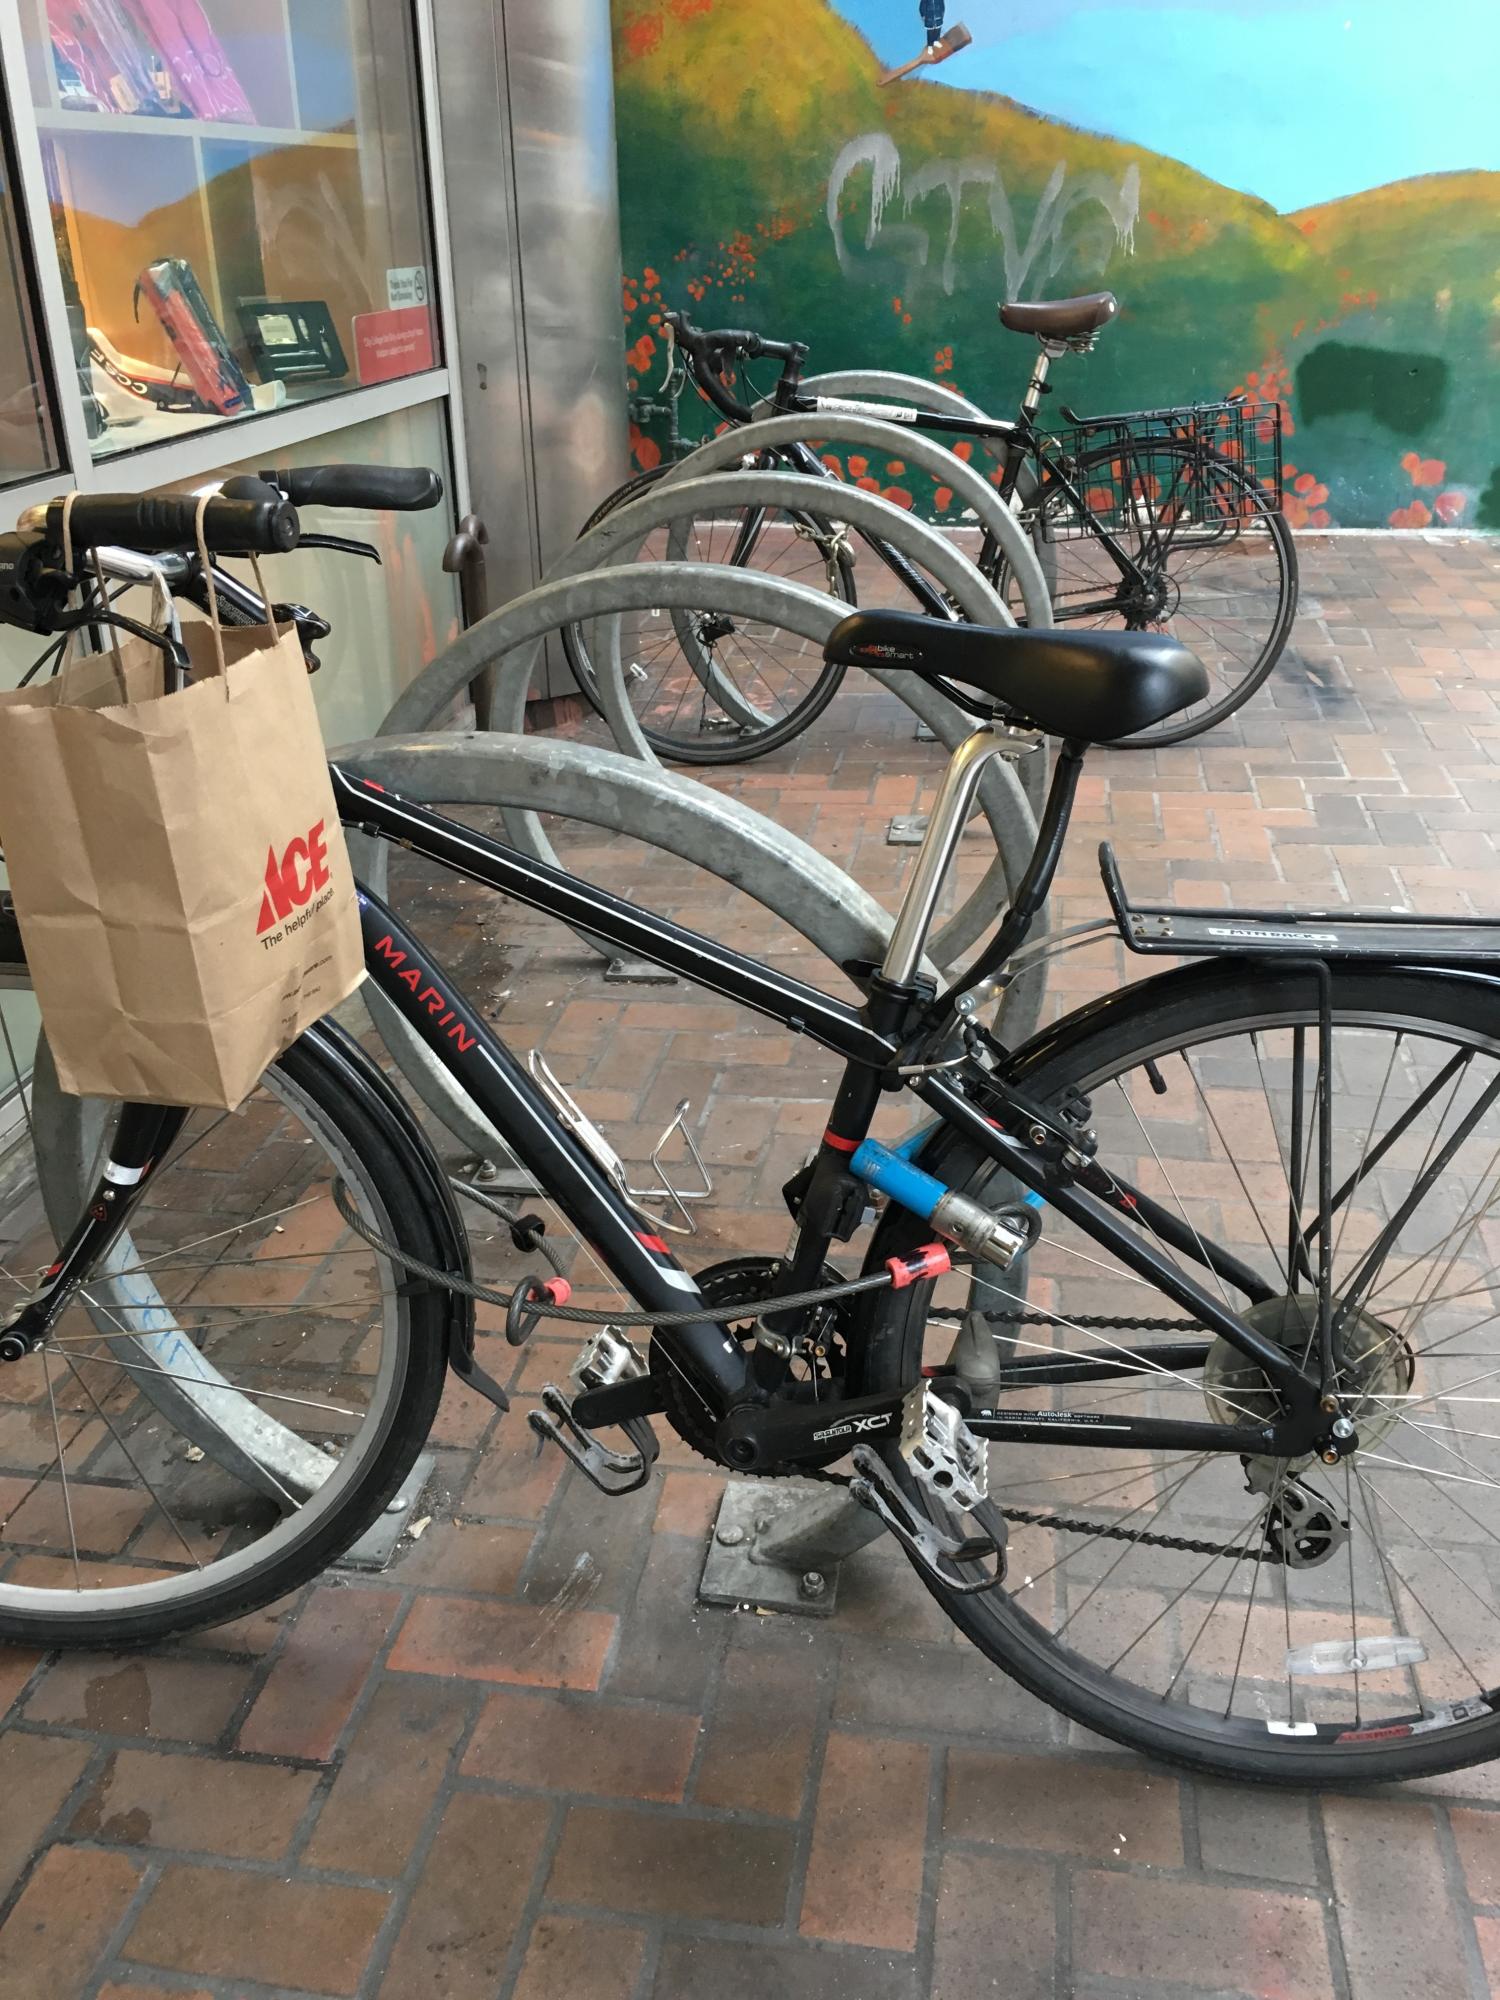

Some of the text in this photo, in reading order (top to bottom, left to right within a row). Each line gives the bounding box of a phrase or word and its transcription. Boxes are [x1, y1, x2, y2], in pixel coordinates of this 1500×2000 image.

[256, 817, 330, 936] ACE
[260, 931, 283, 951] The
[374, 935, 477, 1053] MARIN
[852, 1412, 893, 1433] XCT
[1037, 1410, 1072, 1418] Autodesk
